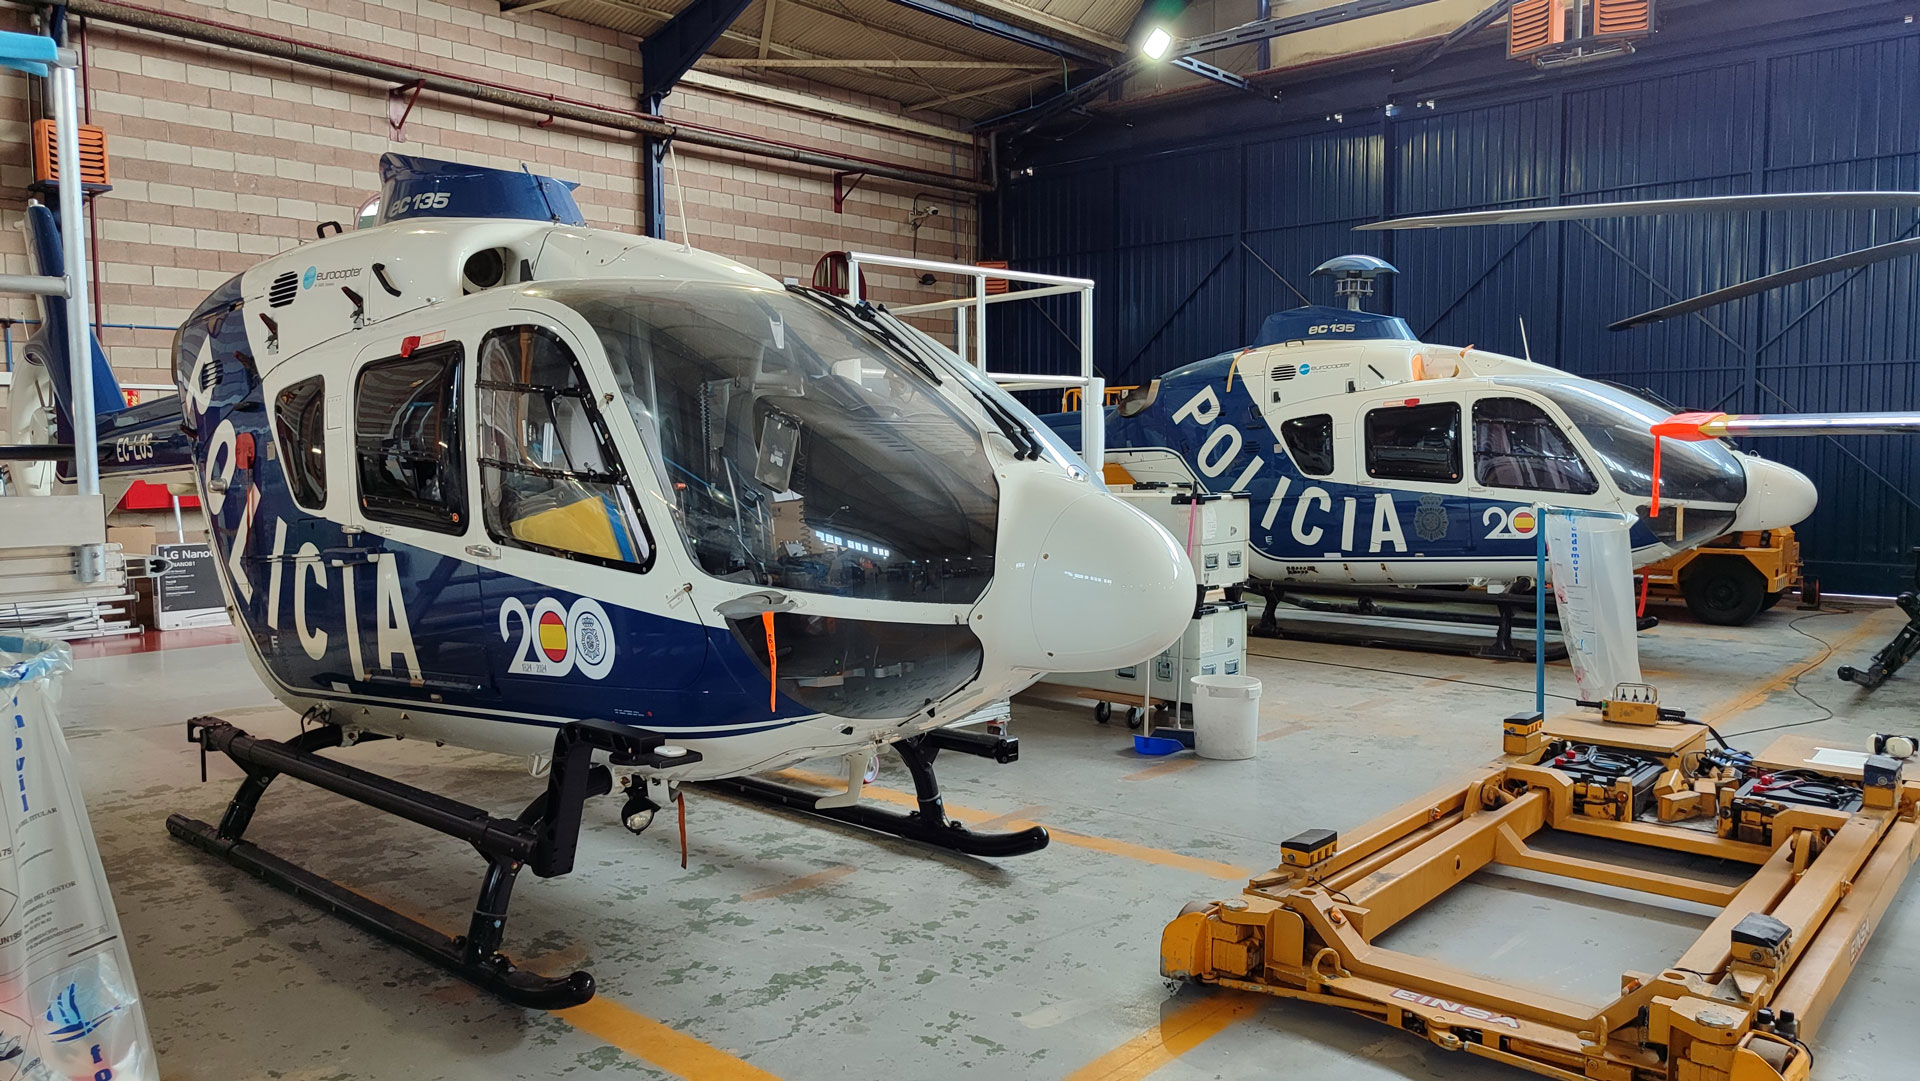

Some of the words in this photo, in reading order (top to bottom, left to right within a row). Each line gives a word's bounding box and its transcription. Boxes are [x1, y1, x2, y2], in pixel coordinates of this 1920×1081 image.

[413, 192, 451, 210] 135
[316, 268, 363, 280] eurocopter
[1329, 323, 1355, 333] 135
[1311, 362, 1351, 371] eurocopter
[186, 334, 424, 682] POLICIA
[1482, 506, 1538, 540] 20
[163, 550, 179, 560] LG
[499, 596, 616, 680] 200
[46, 880, 77, 895] GESTOR
[1390, 988, 1520, 1029] EINSA
